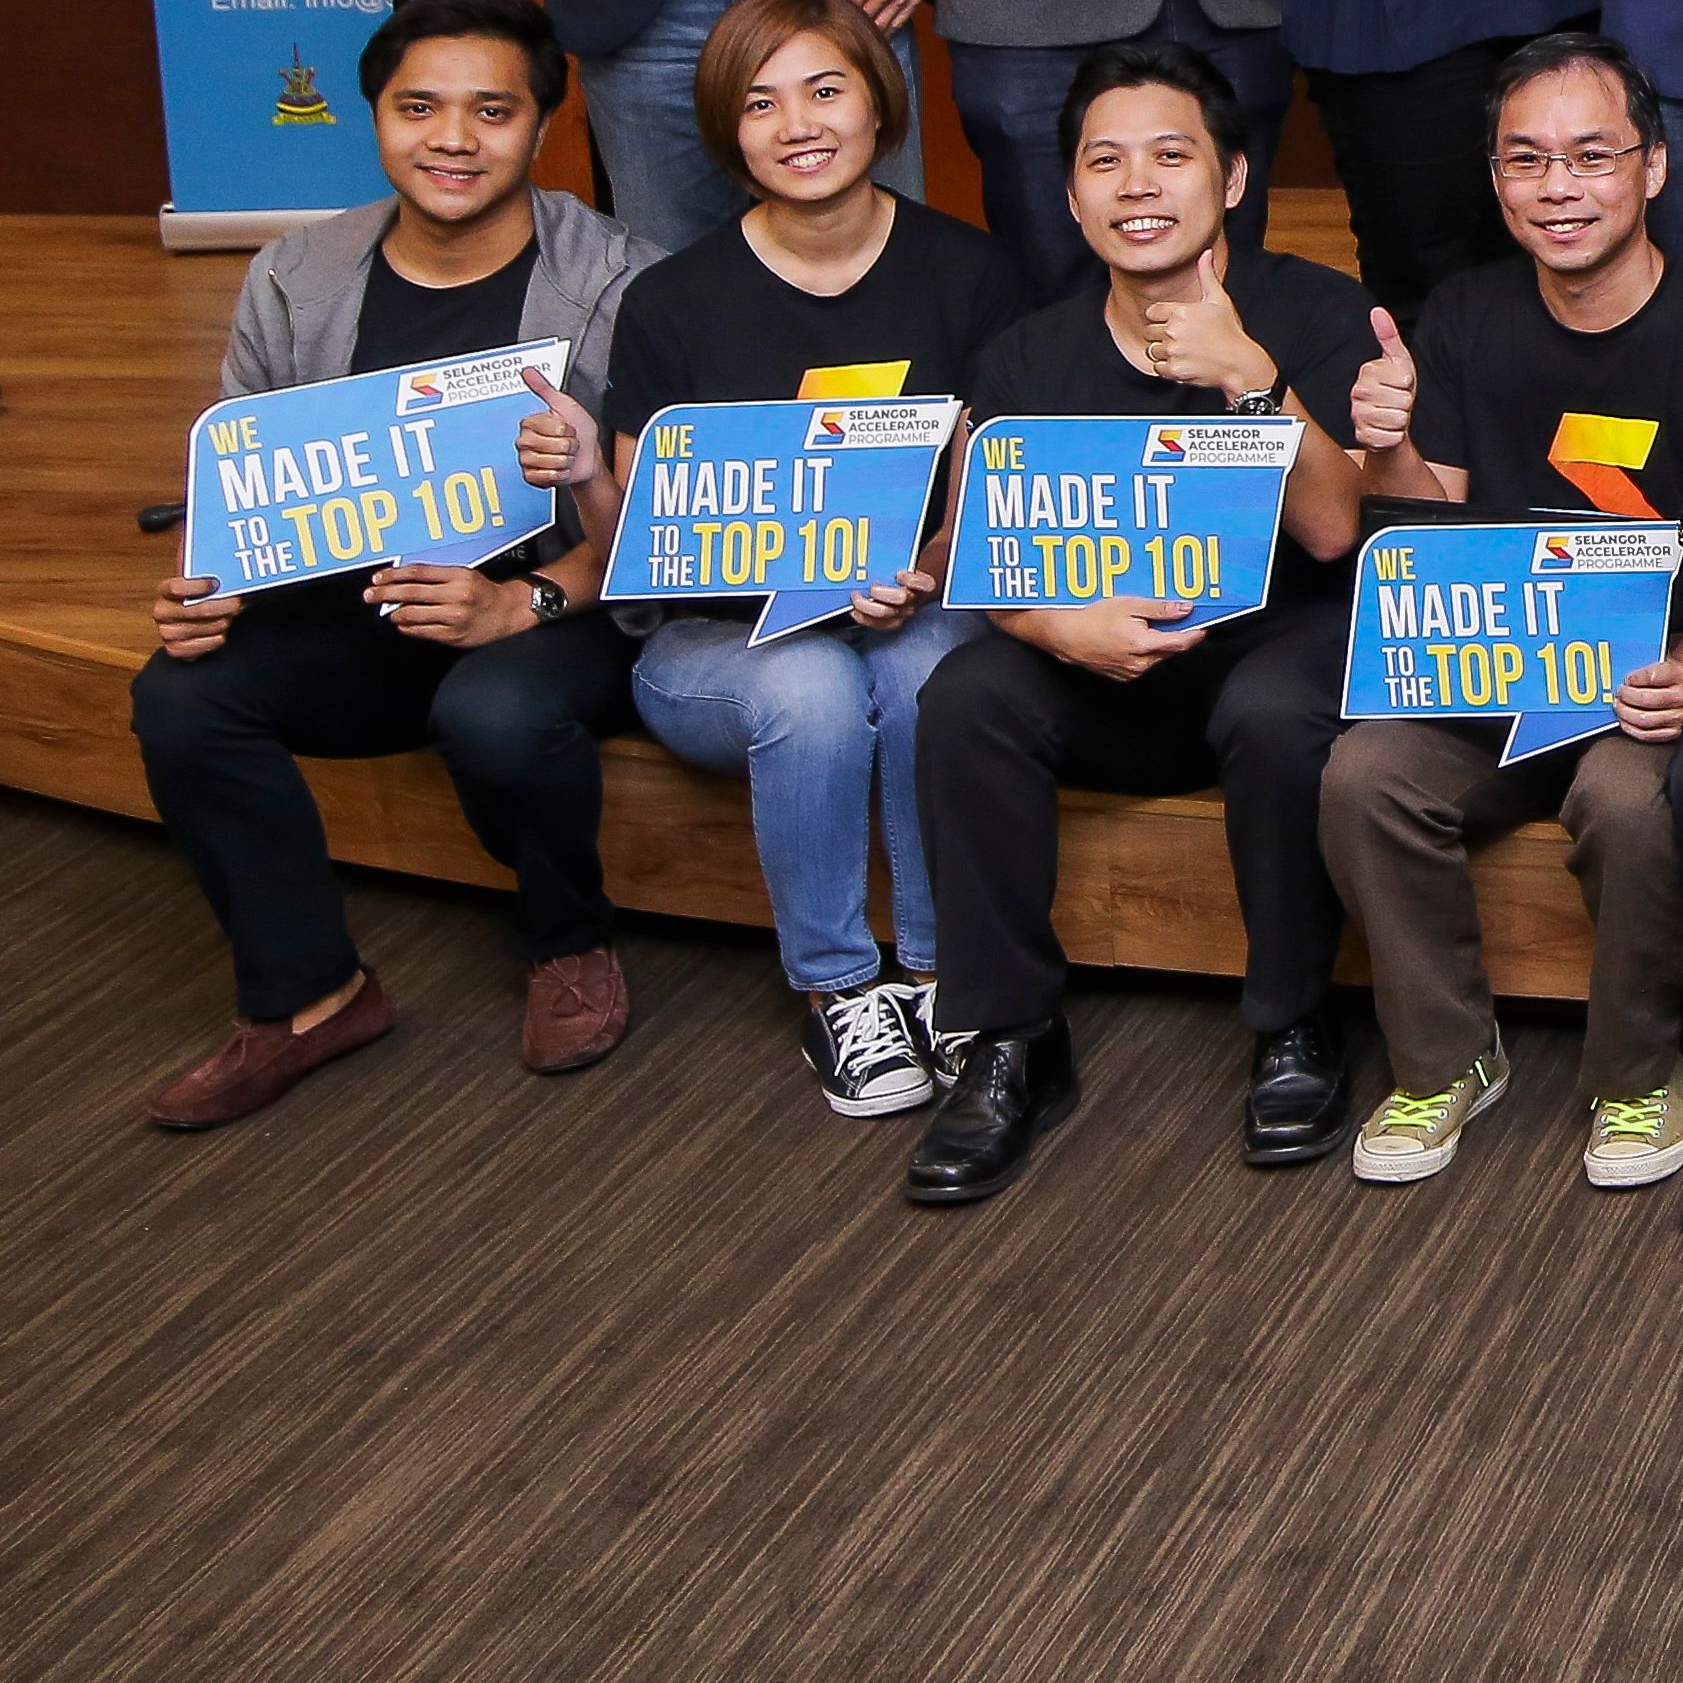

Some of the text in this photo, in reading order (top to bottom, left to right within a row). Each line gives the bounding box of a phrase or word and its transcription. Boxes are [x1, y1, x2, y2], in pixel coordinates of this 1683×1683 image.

[208, 415, 263, 455] WE
[655, 425, 693, 459] WE
[982, 437, 1026, 470] WE
[217, 419, 437, 514] MADE IT
[652, 455, 833, 518] MADE IT
[986, 474, 1176, 530] MADE IT
[228, 516, 269, 551] TO
[283, 466, 506, 568] TOP 10!
[649, 524, 681, 557] TO
[693, 516, 870, 585] TOP 10!
[989, 536, 1022, 569] TO
[235, 540, 297, 582] THE
[648, 554, 694, 587] THE
[1033, 535, 1222, 600] TOP 10!
[1373, 548, 1417, 581] WE
[989, 566, 1039, 600] THE
[1378, 582, 1564, 640] MADE IT
[1382, 647, 1414, 677] TO
[1426, 641, 1613, 707] TOP 10!
[1385, 676, 1434, 708] THE
